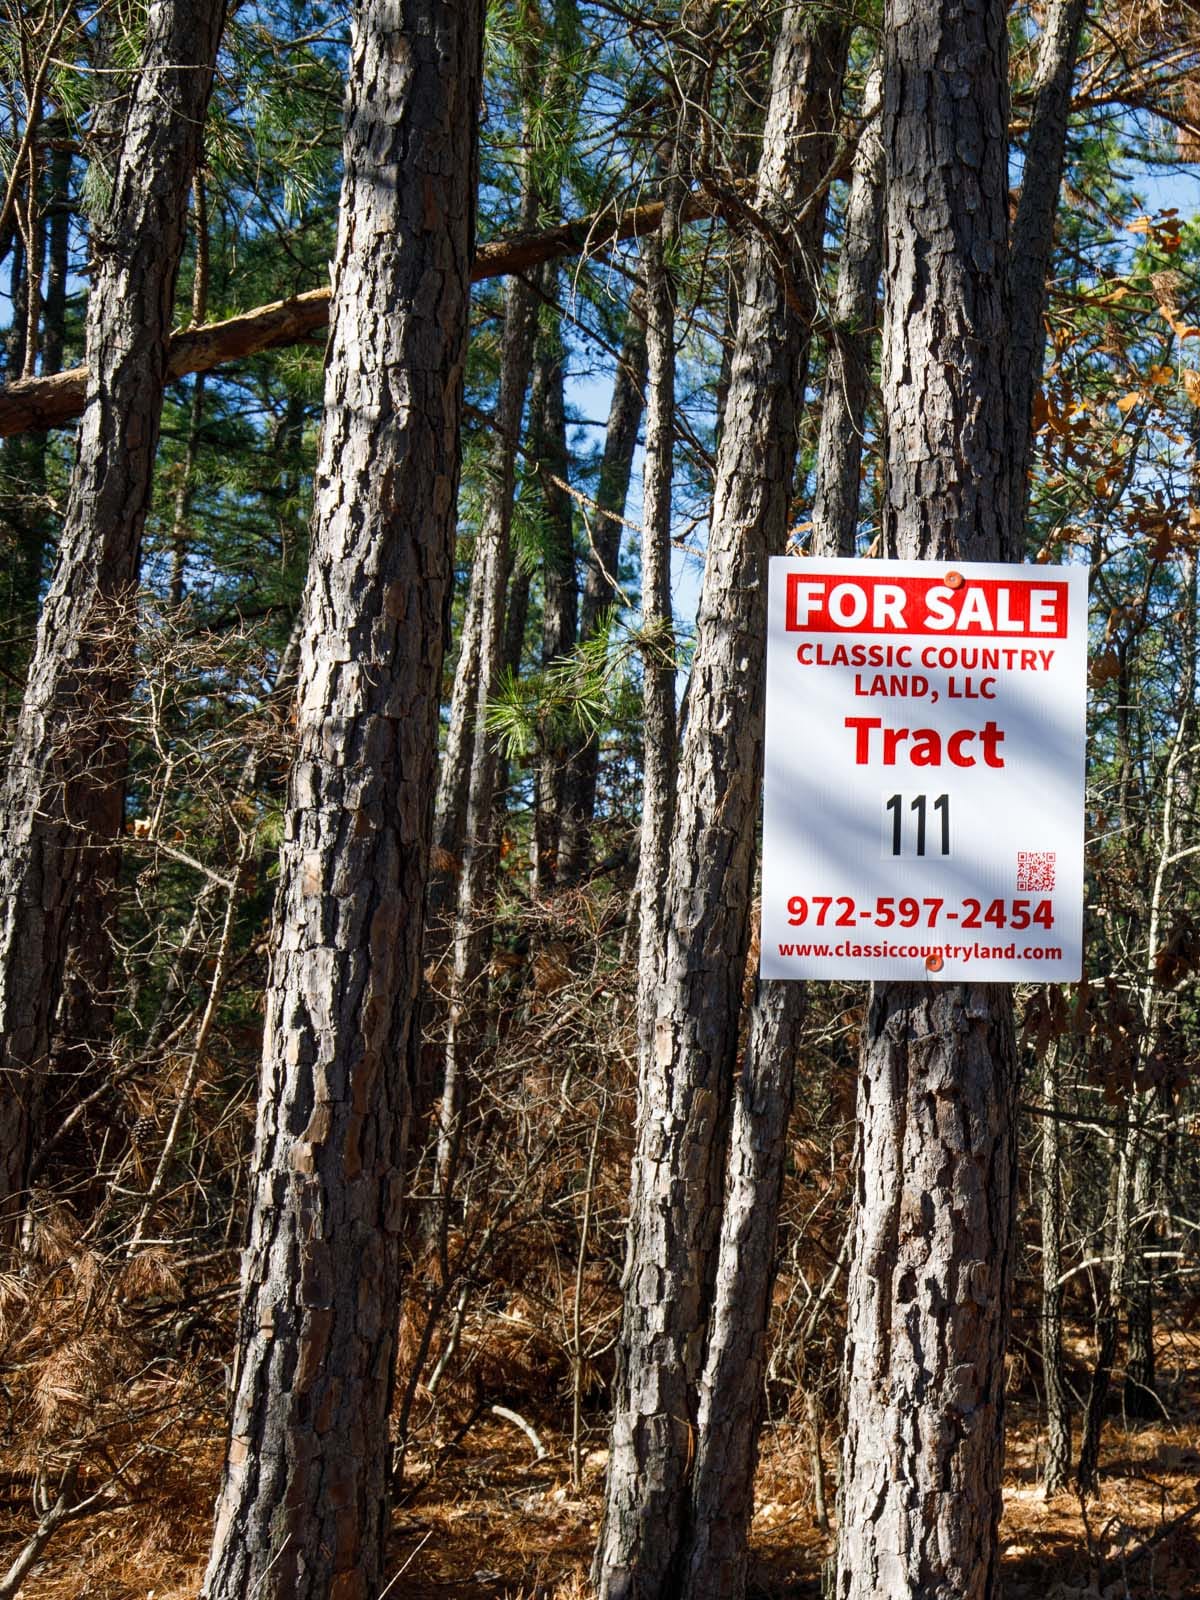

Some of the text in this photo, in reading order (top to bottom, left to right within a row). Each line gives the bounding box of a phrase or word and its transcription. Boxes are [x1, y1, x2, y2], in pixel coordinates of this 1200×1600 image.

[796, 582, 1058, 633] FOR SALE
[797, 643, 1055, 671] CLASSIC COUNTRY
[854, 674, 996, 704] LAND, LLC
[844, 717, 1005, 768] Tract
[886, 793, 950, 857] 111
[787, 896, 1055, 930] 972-597-2454
[779, 941, 1062, 963] www.classiccountryland.com
